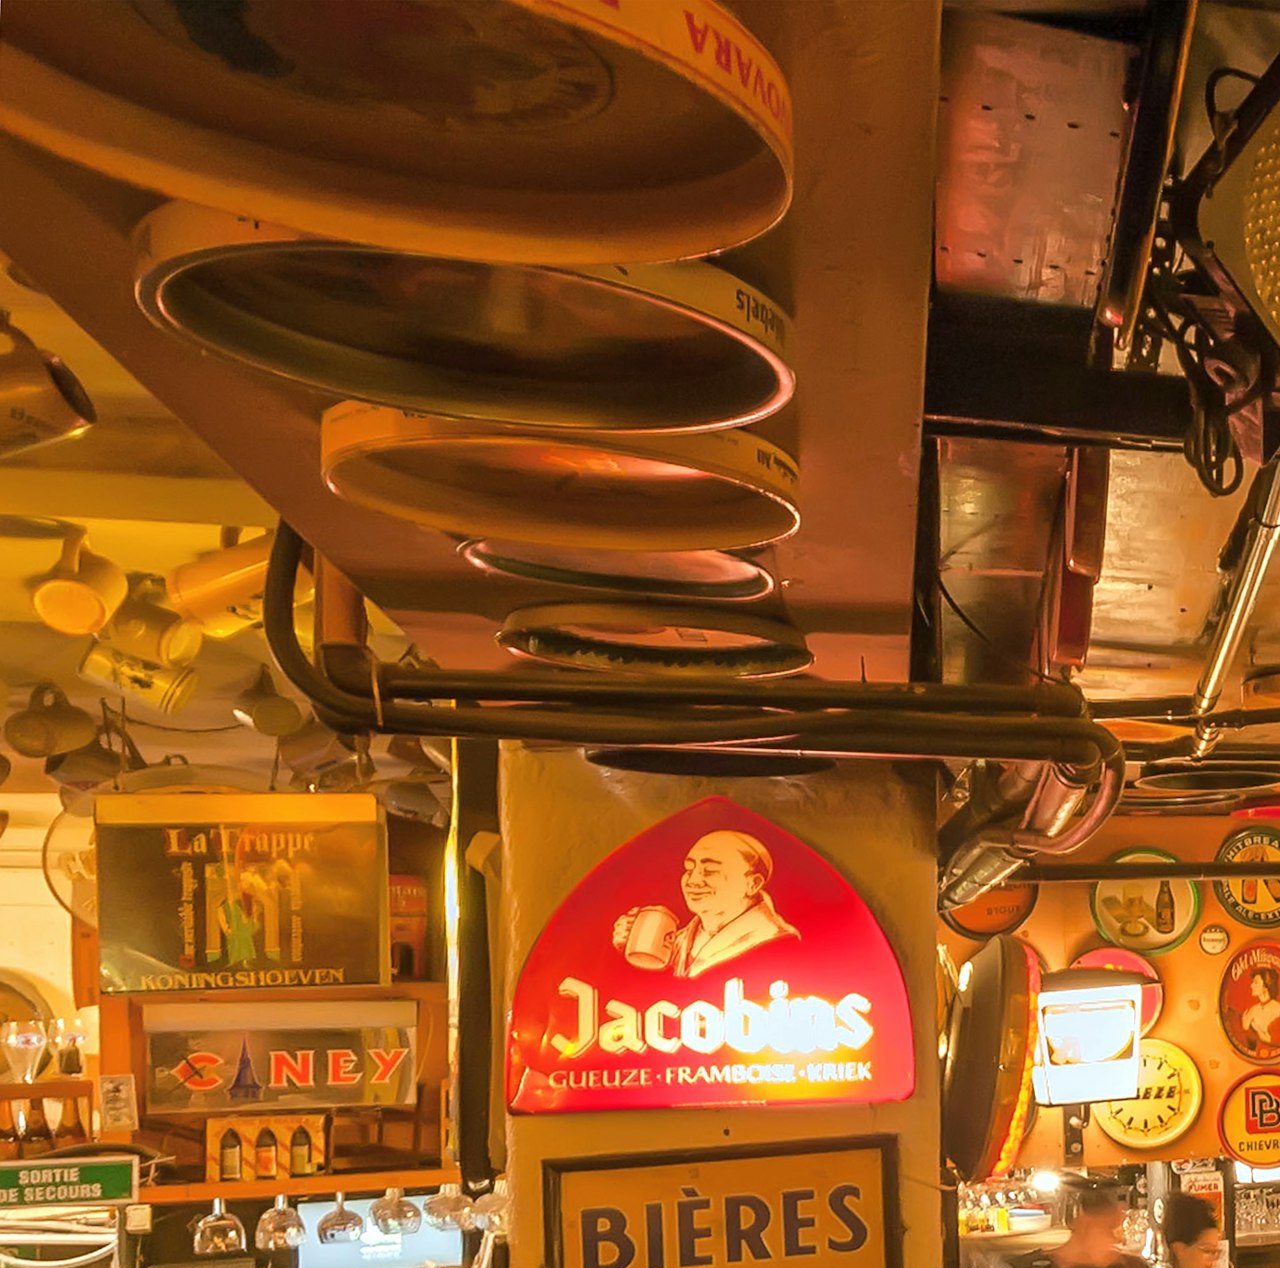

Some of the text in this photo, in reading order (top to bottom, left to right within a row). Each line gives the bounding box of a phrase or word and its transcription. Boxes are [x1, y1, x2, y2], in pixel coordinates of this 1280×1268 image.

[165, 826, 317, 858] La Trappe
[140, 967, 345, 989] KONINGSHOEVEN
[550, 976, 874, 1059] Jacobins
[549, 1067, 653, 1090] GUEUZE
[18, 1167, 80, 1185] SORTIE
[22, 1183, 103, 1202] SECOURS
